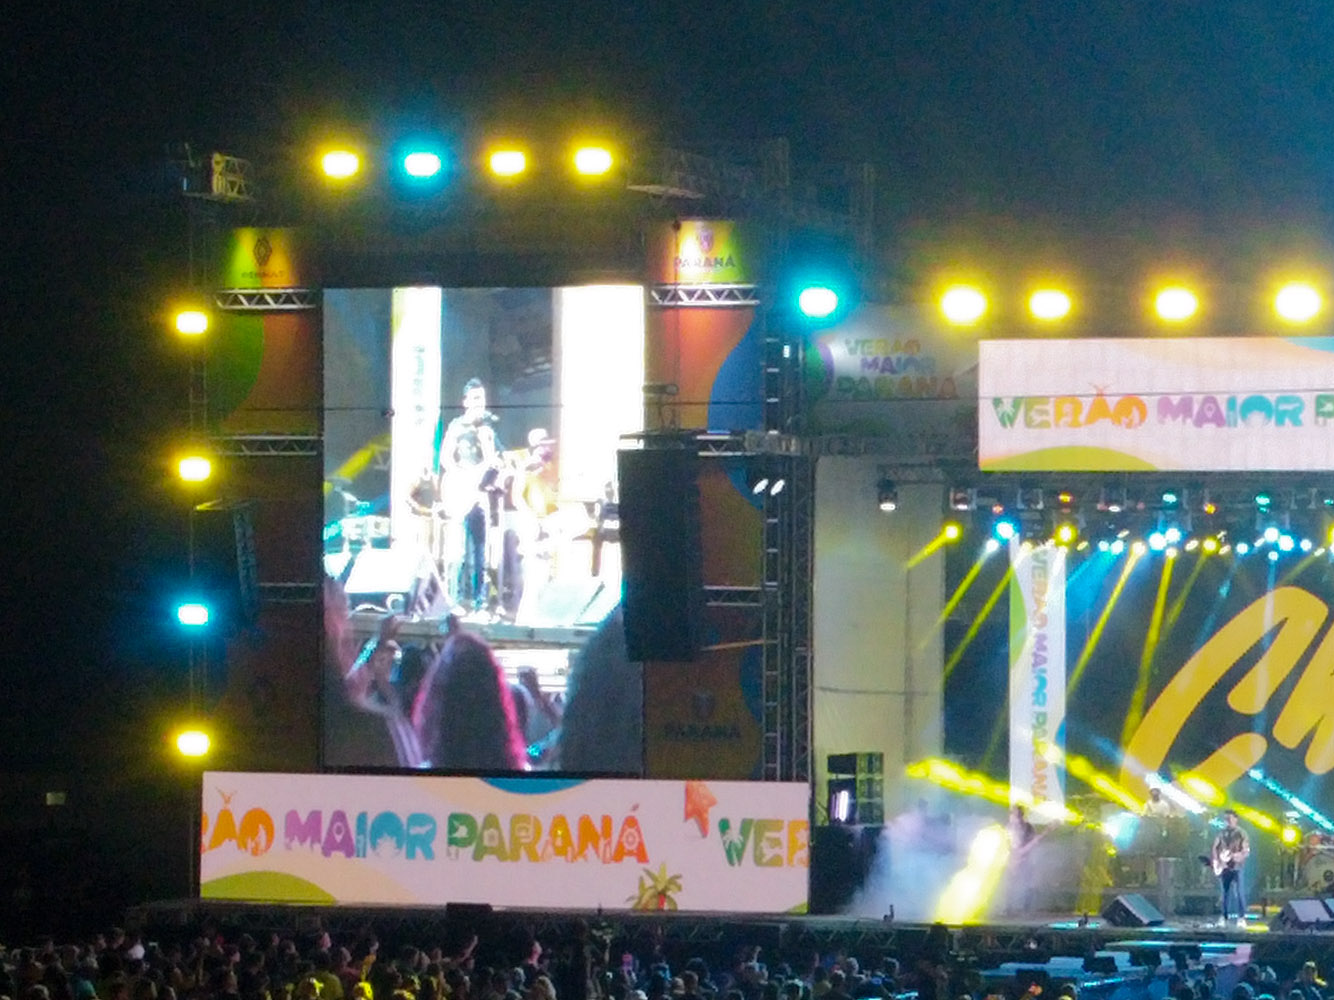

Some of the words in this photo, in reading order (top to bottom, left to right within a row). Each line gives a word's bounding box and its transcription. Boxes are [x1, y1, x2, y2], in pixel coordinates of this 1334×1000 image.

[992, 383, 1148, 430] VERÃO
[1156, 394, 1306, 429] MAIOR
[284, 808, 438, 860] MAIOR
[446, 802, 650, 864] PARANÁ
